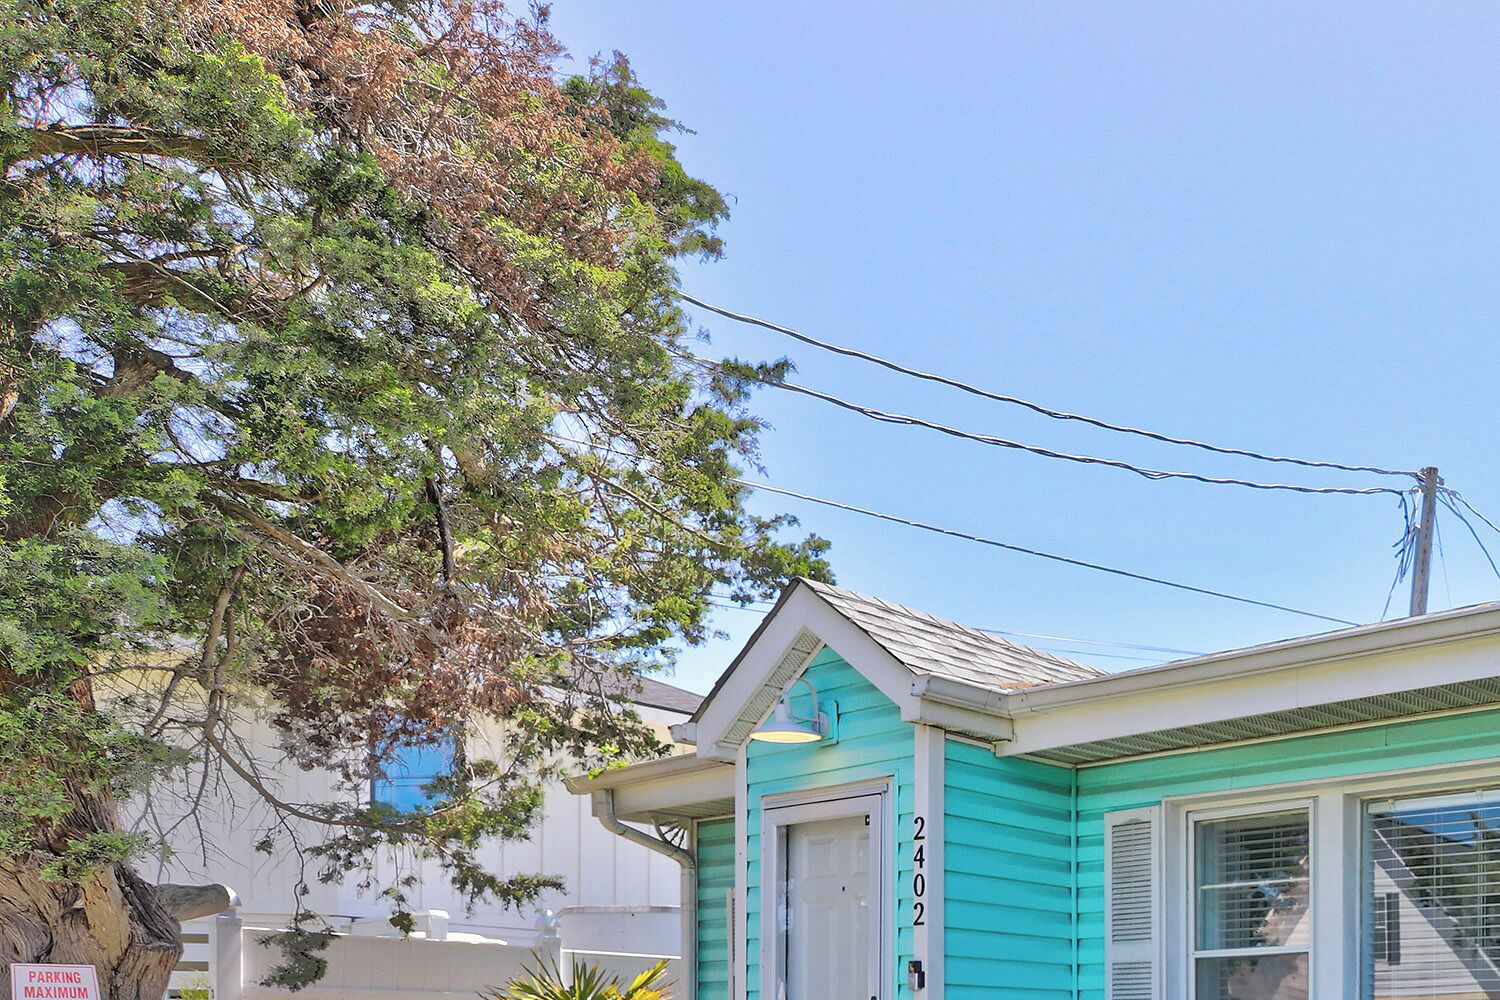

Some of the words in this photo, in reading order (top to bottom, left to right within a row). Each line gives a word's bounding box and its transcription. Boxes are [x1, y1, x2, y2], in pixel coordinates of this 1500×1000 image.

[913, 816, 926, 926] 2402
[28, 971, 81, 983] PARKING
[24, 986, 88, 999] MAXIMUM
